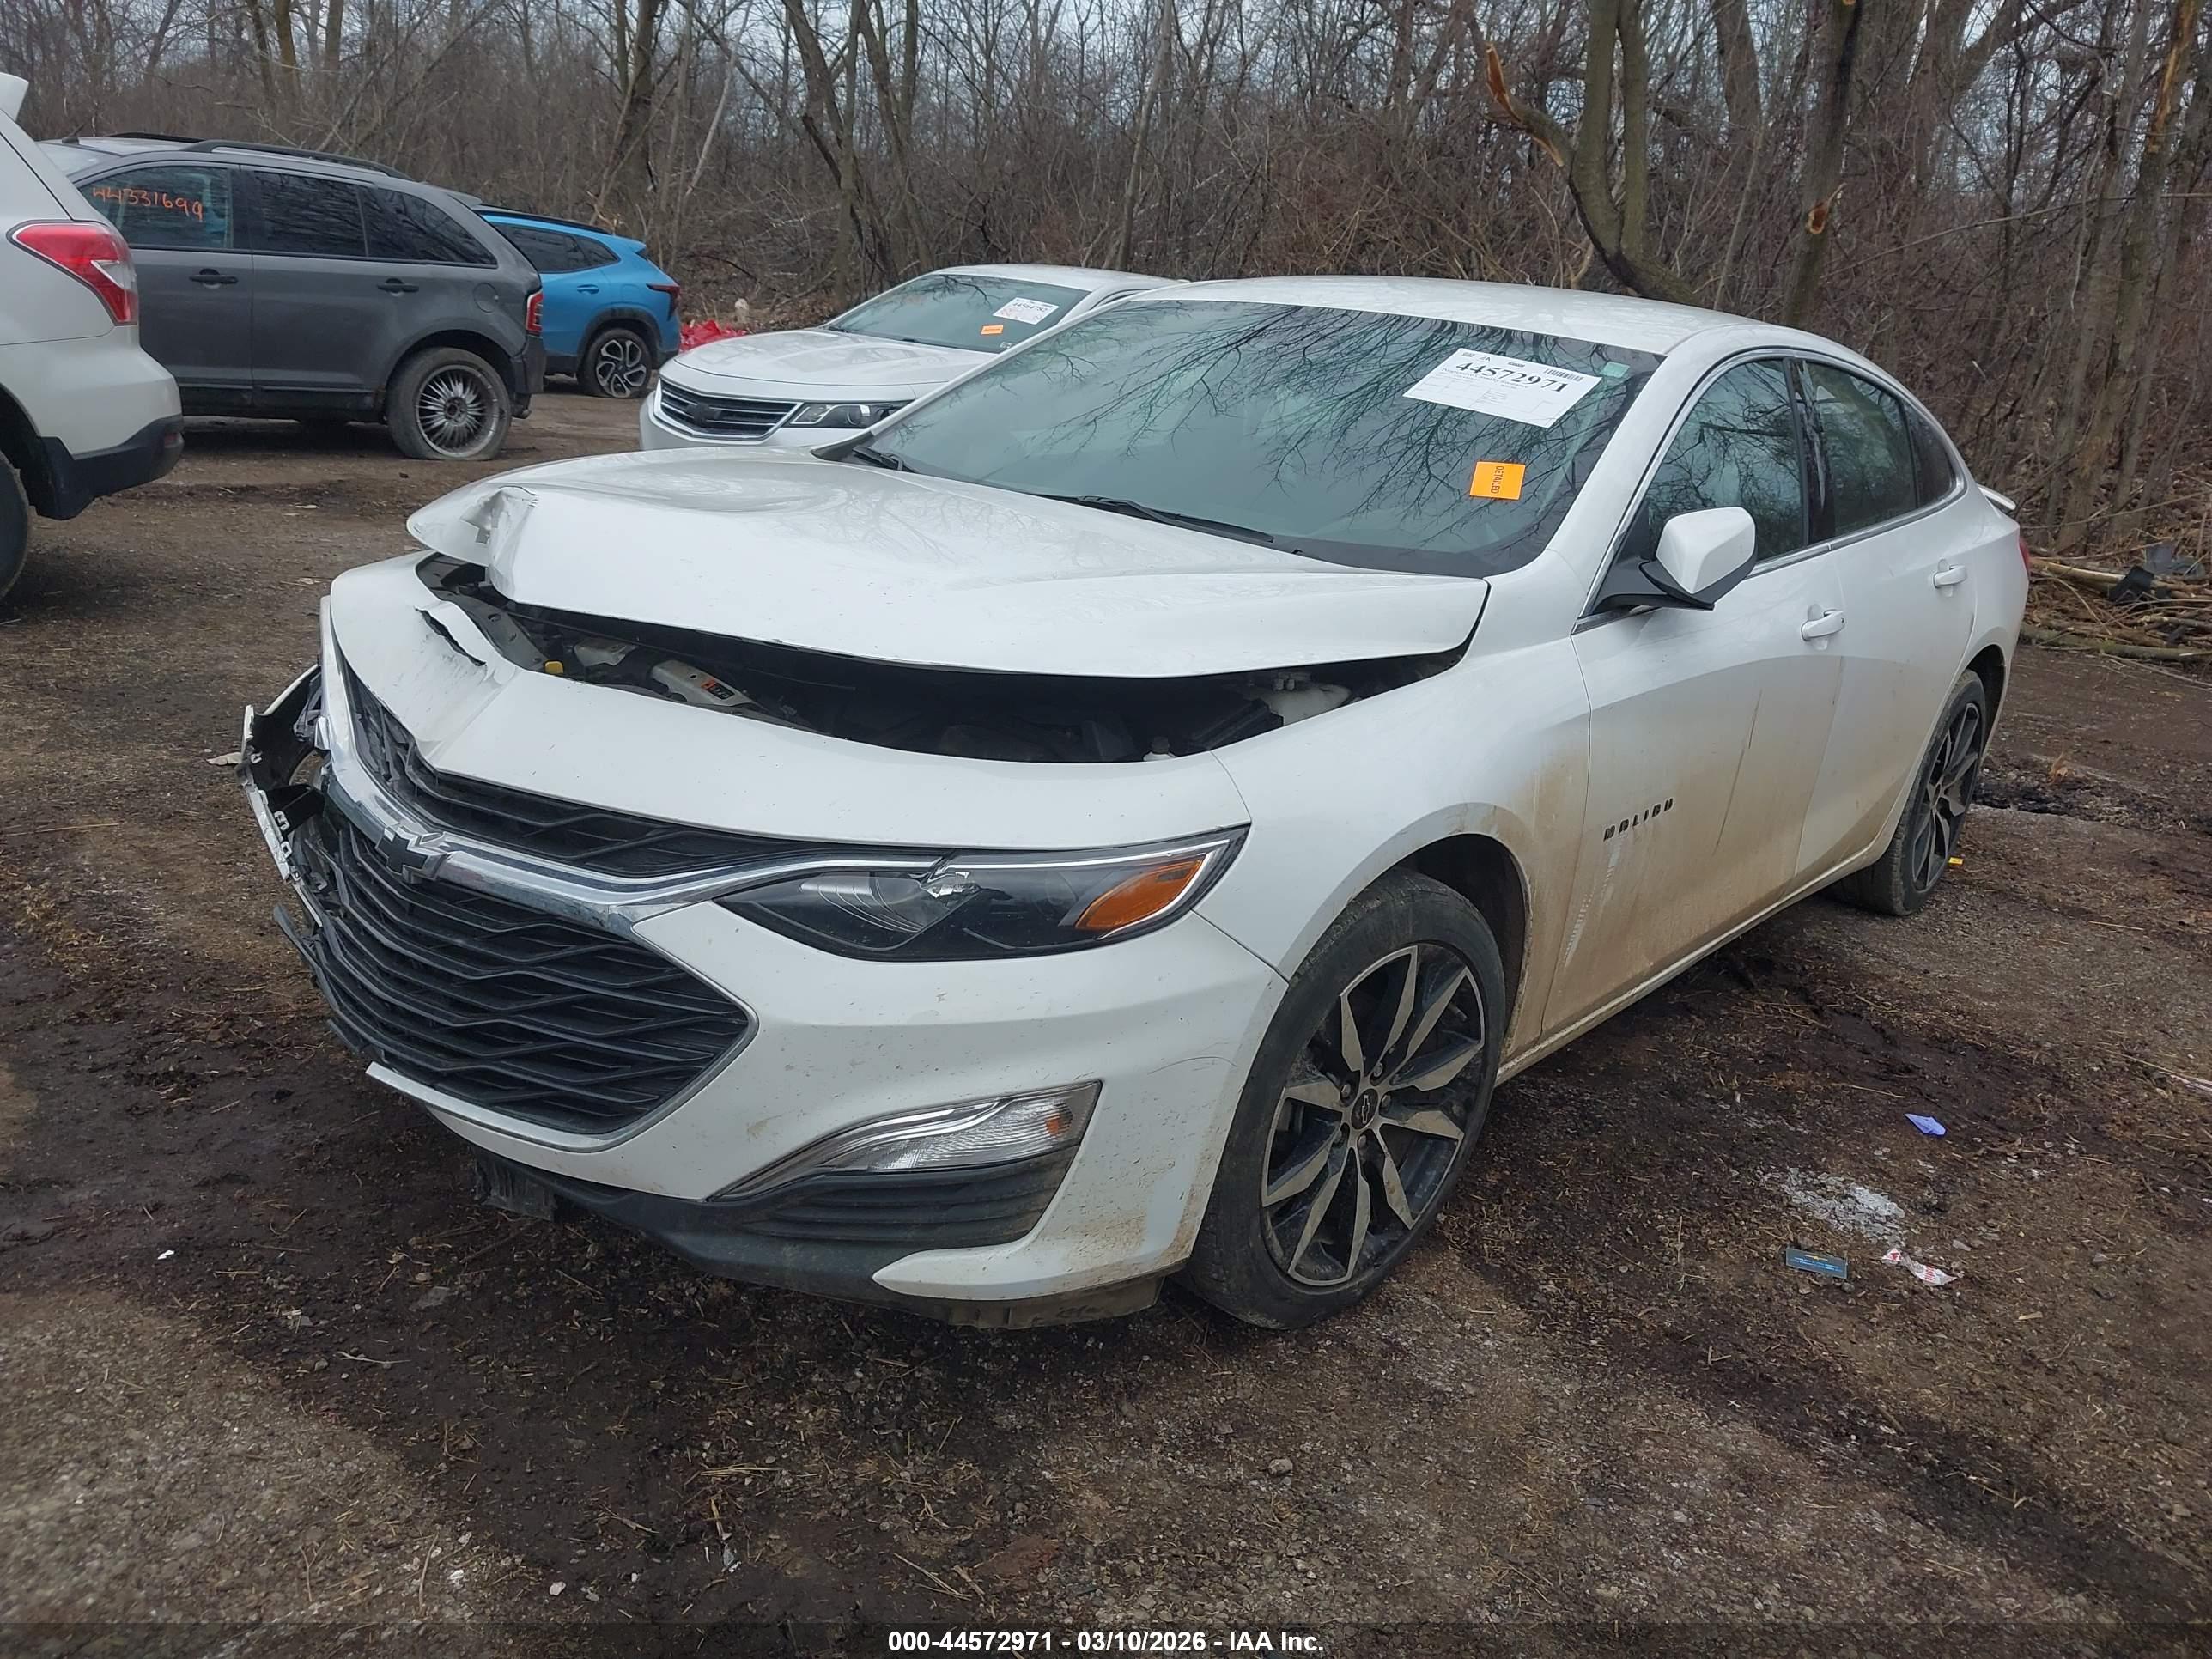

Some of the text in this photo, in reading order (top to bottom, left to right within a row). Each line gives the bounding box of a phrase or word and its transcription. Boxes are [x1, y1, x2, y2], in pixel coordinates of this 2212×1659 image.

[92, 187, 204, 222] 44331699
[1455, 362, 1569, 392] 44572971
[1490, 465, 1505, 494] DETAILED
